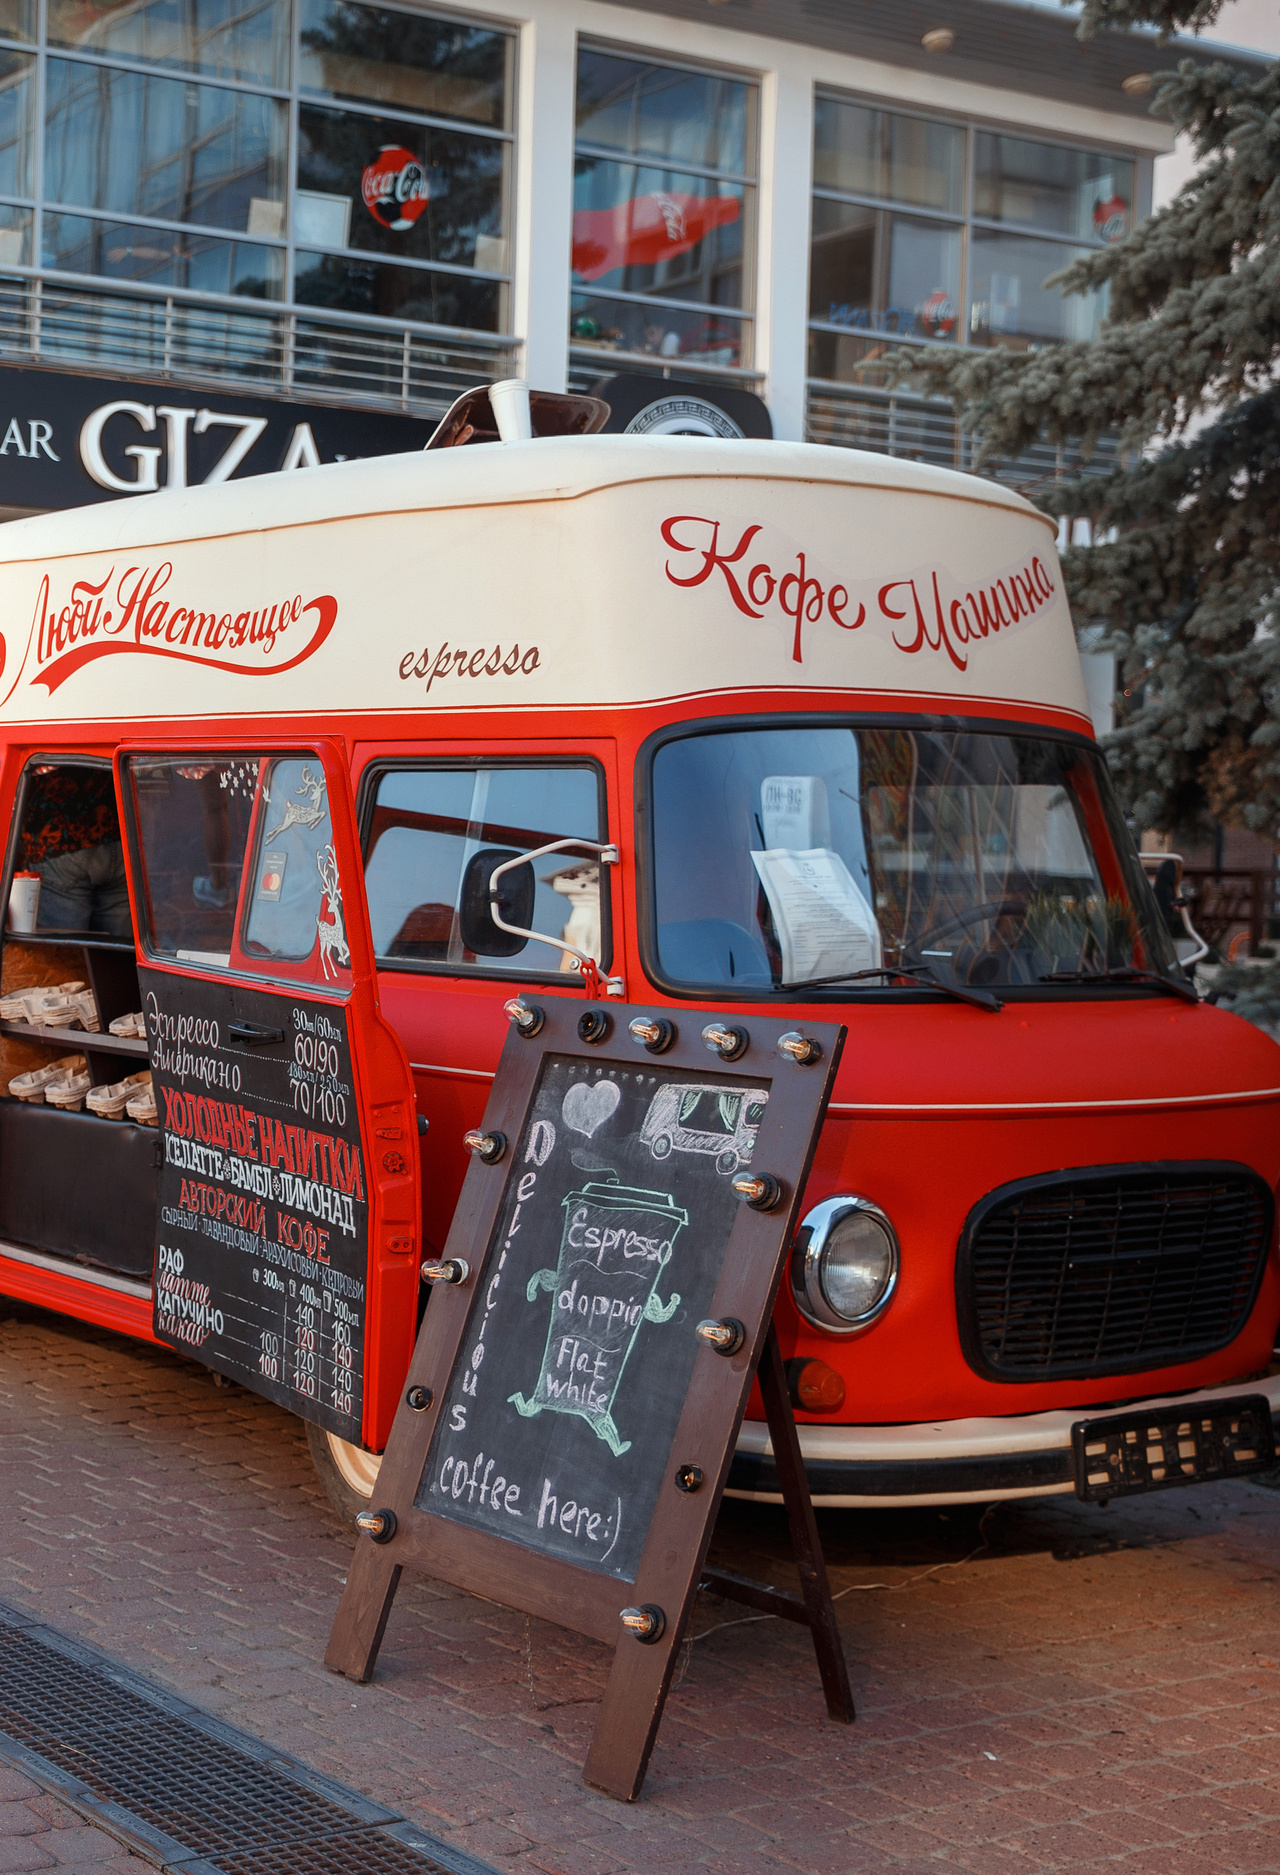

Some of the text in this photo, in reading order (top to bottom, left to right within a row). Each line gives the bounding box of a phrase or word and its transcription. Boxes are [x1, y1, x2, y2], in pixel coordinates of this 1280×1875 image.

[103, 560, 305, 656] Настоящее
[660, 514, 1055, 673] Кофе Машина
[399, 640, 541, 695] espresso
[147, 991, 219, 1051] Эспрессо
[151, 1038, 241, 1092] Американо
[293, 1033, 339, 1079] 60/90
[289, 1078, 346, 1128] 70/100
[160, 1086, 366, 1203] ХОЛОДНЫЕ НАПИТКИ
[178, 1177, 331, 1266] АВТОРСКИЙ КОФЕ
[229, 1156, 274, 1201] БАМБЛ
[278, 1172, 357, 1238] ЛИМОНАД
[161, 1205, 198, 1232] СЫРНЫЙ
[201, 1216, 259, 1256] ЛАВАНДОВЫЙ
[568, 1207, 672, 1266] Espresso
[157, 1270, 352, 1368] латте 120 140
[158, 1244, 351, 1347] РАФ 140 160
[558, 1279, 644, 1334] doppio
[157, 1289, 352, 1392] КАПУЧИНО 100 120 140
[157, 1309, 351, 1415] какао 100 120 140
[556, 1337, 608, 1380] Flat
[546, 1371, 608, 1414] white
[440, 1452, 523, 1516] coffee
